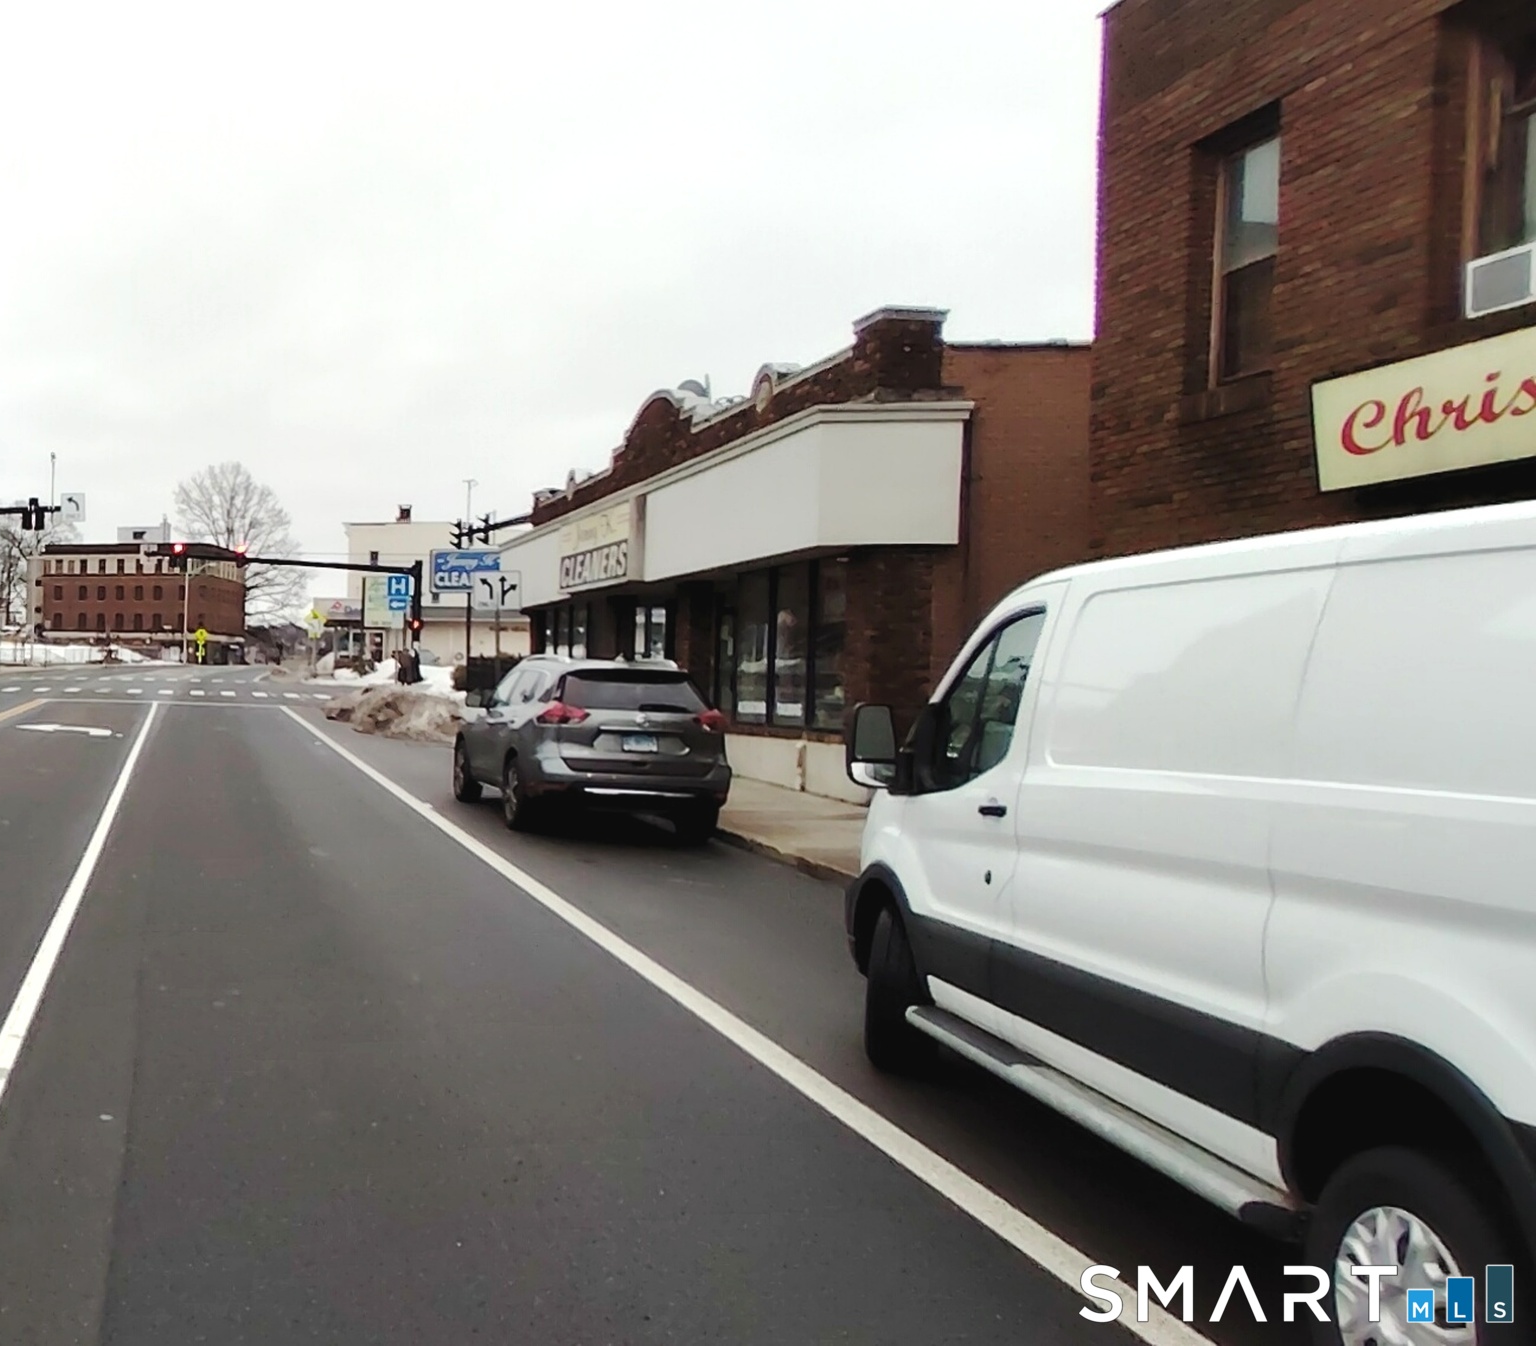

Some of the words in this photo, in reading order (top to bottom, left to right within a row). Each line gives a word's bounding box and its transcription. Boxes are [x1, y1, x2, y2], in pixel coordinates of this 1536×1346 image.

[1341, 370, 1536, 456] Chris
[391, 577, 406, 595] H
[561, 542, 627, 588] CLEANERS
